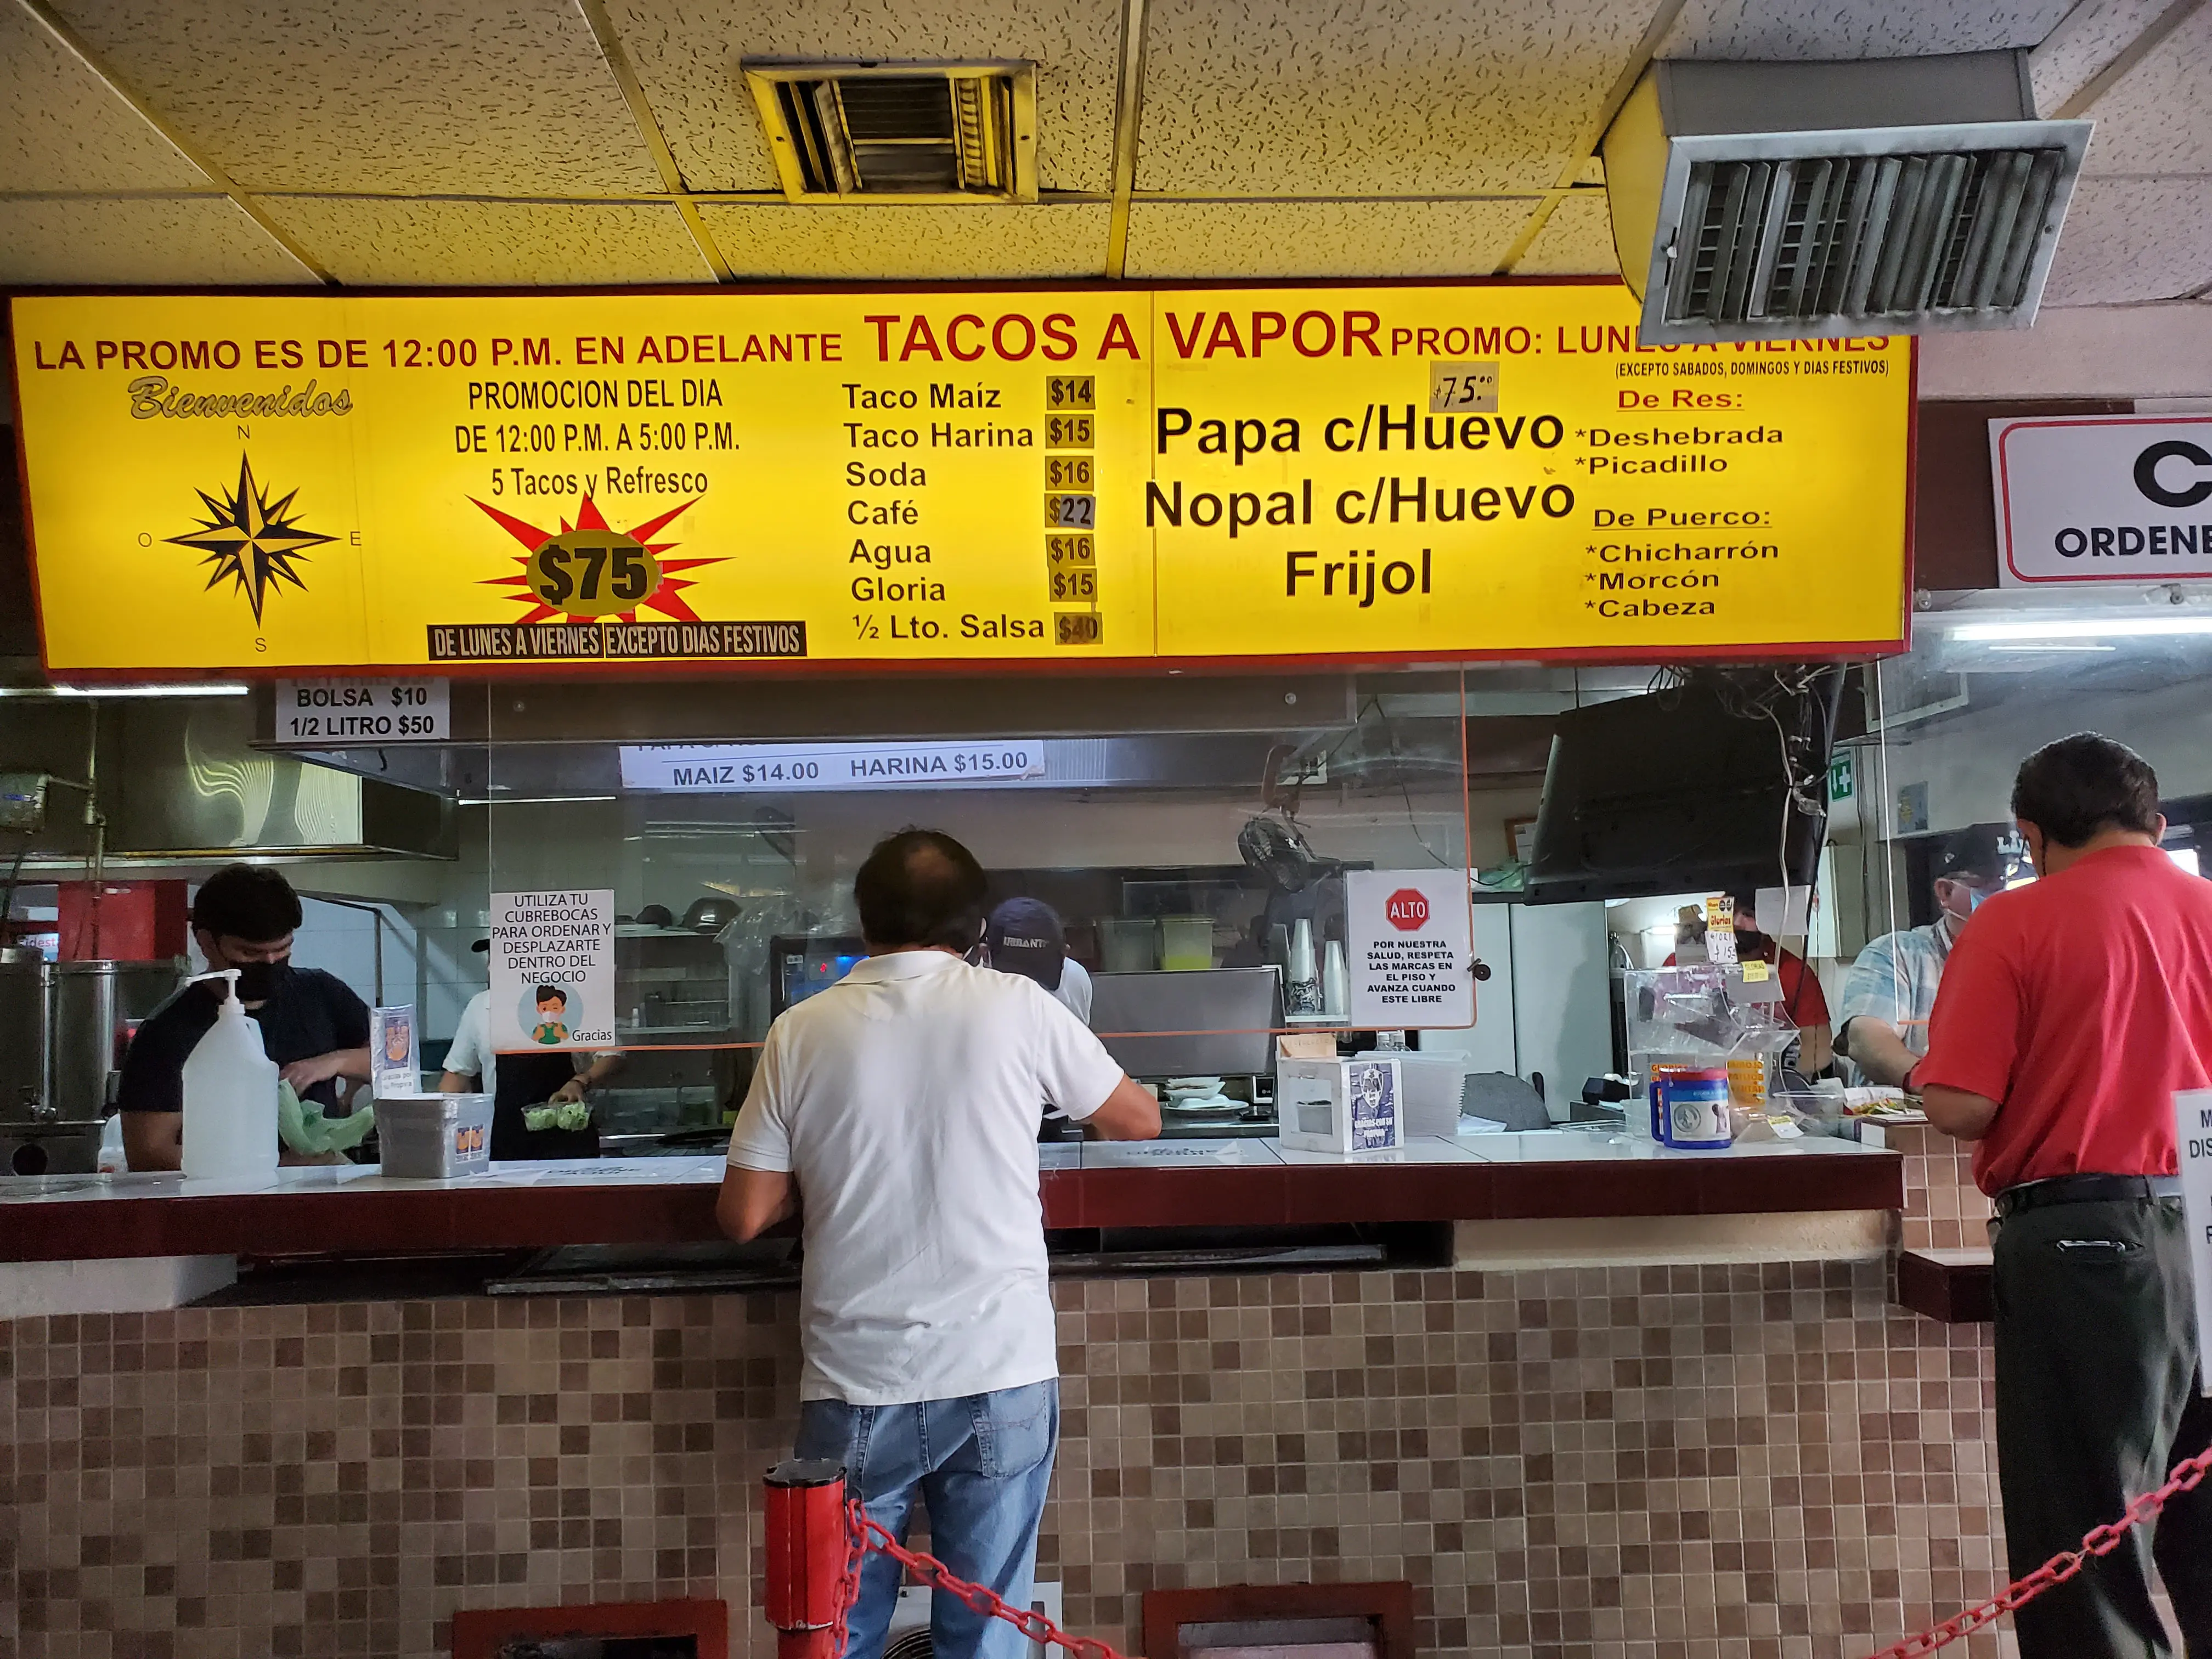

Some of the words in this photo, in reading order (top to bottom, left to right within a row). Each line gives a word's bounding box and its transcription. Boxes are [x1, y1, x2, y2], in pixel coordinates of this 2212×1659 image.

[864, 313, 1079, 362] TACOS
[1097, 313, 1141, 360] A
[1165, 310, 1383, 359] VAPOR
[1392, 326, 1541, 356] PROMO:
[1558, 325, 1681, 354] LUN
[35, 341, 84, 370] LA
[96, 340, 240, 370] PROMO
[256, 340, 303, 368] ES
[319, 340, 369, 368] DE
[383, 338, 477, 367] 12:00
[492, 337, 561, 366] P.M.
[577, 336, 624, 364] EN
[637, 334, 842, 363] ADELANTE
[1616, 362, 1669, 379] (EXCEPTO
[1673, 362, 1727, 379] SABADOS,
[1731, 361, 1790, 376] DOMINGOS
[1794, 361, 1801, 375] Y
[1804, 360, 1829, 375] DIAS
[1833, 359, 1889, 377] FESTIVOS)
[127, 376, 353, 419] Bienvenidos
[469, 380, 618, 409] PROMOCION
[627, 379, 674, 408] DEL
[682, 379, 723, 407] DIA
[842, 383, 917, 409] Taco
[930, 382, 1002, 409] Maíz
[1051, 379, 1092, 405] $14
[1618, 390, 1660, 409] De
[1672, 390, 1743, 408] Res:
[236, 425, 251, 439] N
[456, 425, 487, 453] DE
[495, 424, 555, 453] 12:00
[565, 424, 608, 452] P.M.
[616, 423, 632, 450] A
[640, 422, 686, 450] 5:00
[695, 422, 740, 450] P.M.
[843, 422, 919, 448] Taco
[931, 421, 1034, 448] Harina
[1049, 417, 1091, 445] $15
[1157, 407, 1301, 466] Papa
[1324, 404, 1564, 453] c/Huevo
[492, 469, 504, 495] 5
[511, 468, 578, 495] Tacos
[585, 473, 597, 500] y
[607, 466, 708, 494] Refresco
[846, 461, 927, 488] Soda
[1049, 460, 1090, 488] $16
[848, 500, 918, 526] Café
[1049, 496, 1091, 525] $22
[1146, 478, 1312, 539] Nopal
[1335, 476, 1575, 525] c/Huevo
[1593, 509, 1635, 527] De
[1647, 508, 1770, 526] Puerco:
[138, 532, 153, 548] O
[350, 531, 362, 546] E
[849, 538, 931, 570] Agua
[1051, 537, 1091, 566] $16
[538, 544, 648, 605] $75
[1286, 549, 1431, 608] Frijol
[851, 576, 946, 602] Gloria
[1053, 572, 1094, 599] $15
[891, 614, 949, 640] Lto.
[960, 613, 1044, 639] Salsa
[255, 637, 267, 653] S
[434, 628, 457, 656] DE
[460, 628, 512, 656] LUNES
[515, 627, 529, 656] A
[532, 627, 600, 655] VIERNES
[607, 626, 678, 654] EXCEPTO
[682, 625, 721, 653] DIAS
[724, 624, 800, 653] FESTIVOS
[297, 688, 374, 707] BOLSA
[391, 686, 427, 708] $10
[290, 717, 319, 736] 1/2
[327, 716, 391, 736] LITRO
[398, 714, 434, 737] $50
[673, 766, 735, 786] MAIZ
[742, 761, 819, 783] $14.00
[851, 755, 947, 777] HARINA
[953, 752, 1028, 774] $15.00
[514, 894, 567, 907] UTILIZA
[569, 893, 588, 905] TU
[1390, 901, 1425, 919] ALTO
[505, 908, 598, 923] CUBREBOCAS
[1710, 914, 1731, 926] Glorias
[492, 926, 528, 939] PARA
[532, 923, 600, 938] ORDENAR
[602, 923, 611, 935] Y
[503, 939, 601, 954] DESPLAZARTE
[1373, 941, 1394, 949] POR
[1397, 940, 1447, 949] NUESTRA
[508, 956, 566, 969] DENTRO
[569, 955, 596, 967] DEL
[1367, 952, 1404, 961] SALUD,
[1407, 951, 1454, 960] RESPETA
[1369, 962, 1389, 970] LAS
[1391, 962, 1435, 970] MARCAS
[1437, 962, 1453, 970] EN
[521, 970, 586, 984] NEGOCIO
[1367, 984, 1409, 992] AVANZA
[1412, 984, 1456, 992] CUANDO
[1386, 973, 1399, 981] EL
[1402, 973, 1426, 981] PISO
[1428, 973, 1436, 981] Y
[1381, 995, 1409, 1003] ESTE
[1411, 995, 1442, 1003] LIBRE
[572, 1029, 612, 1041] Gracias
